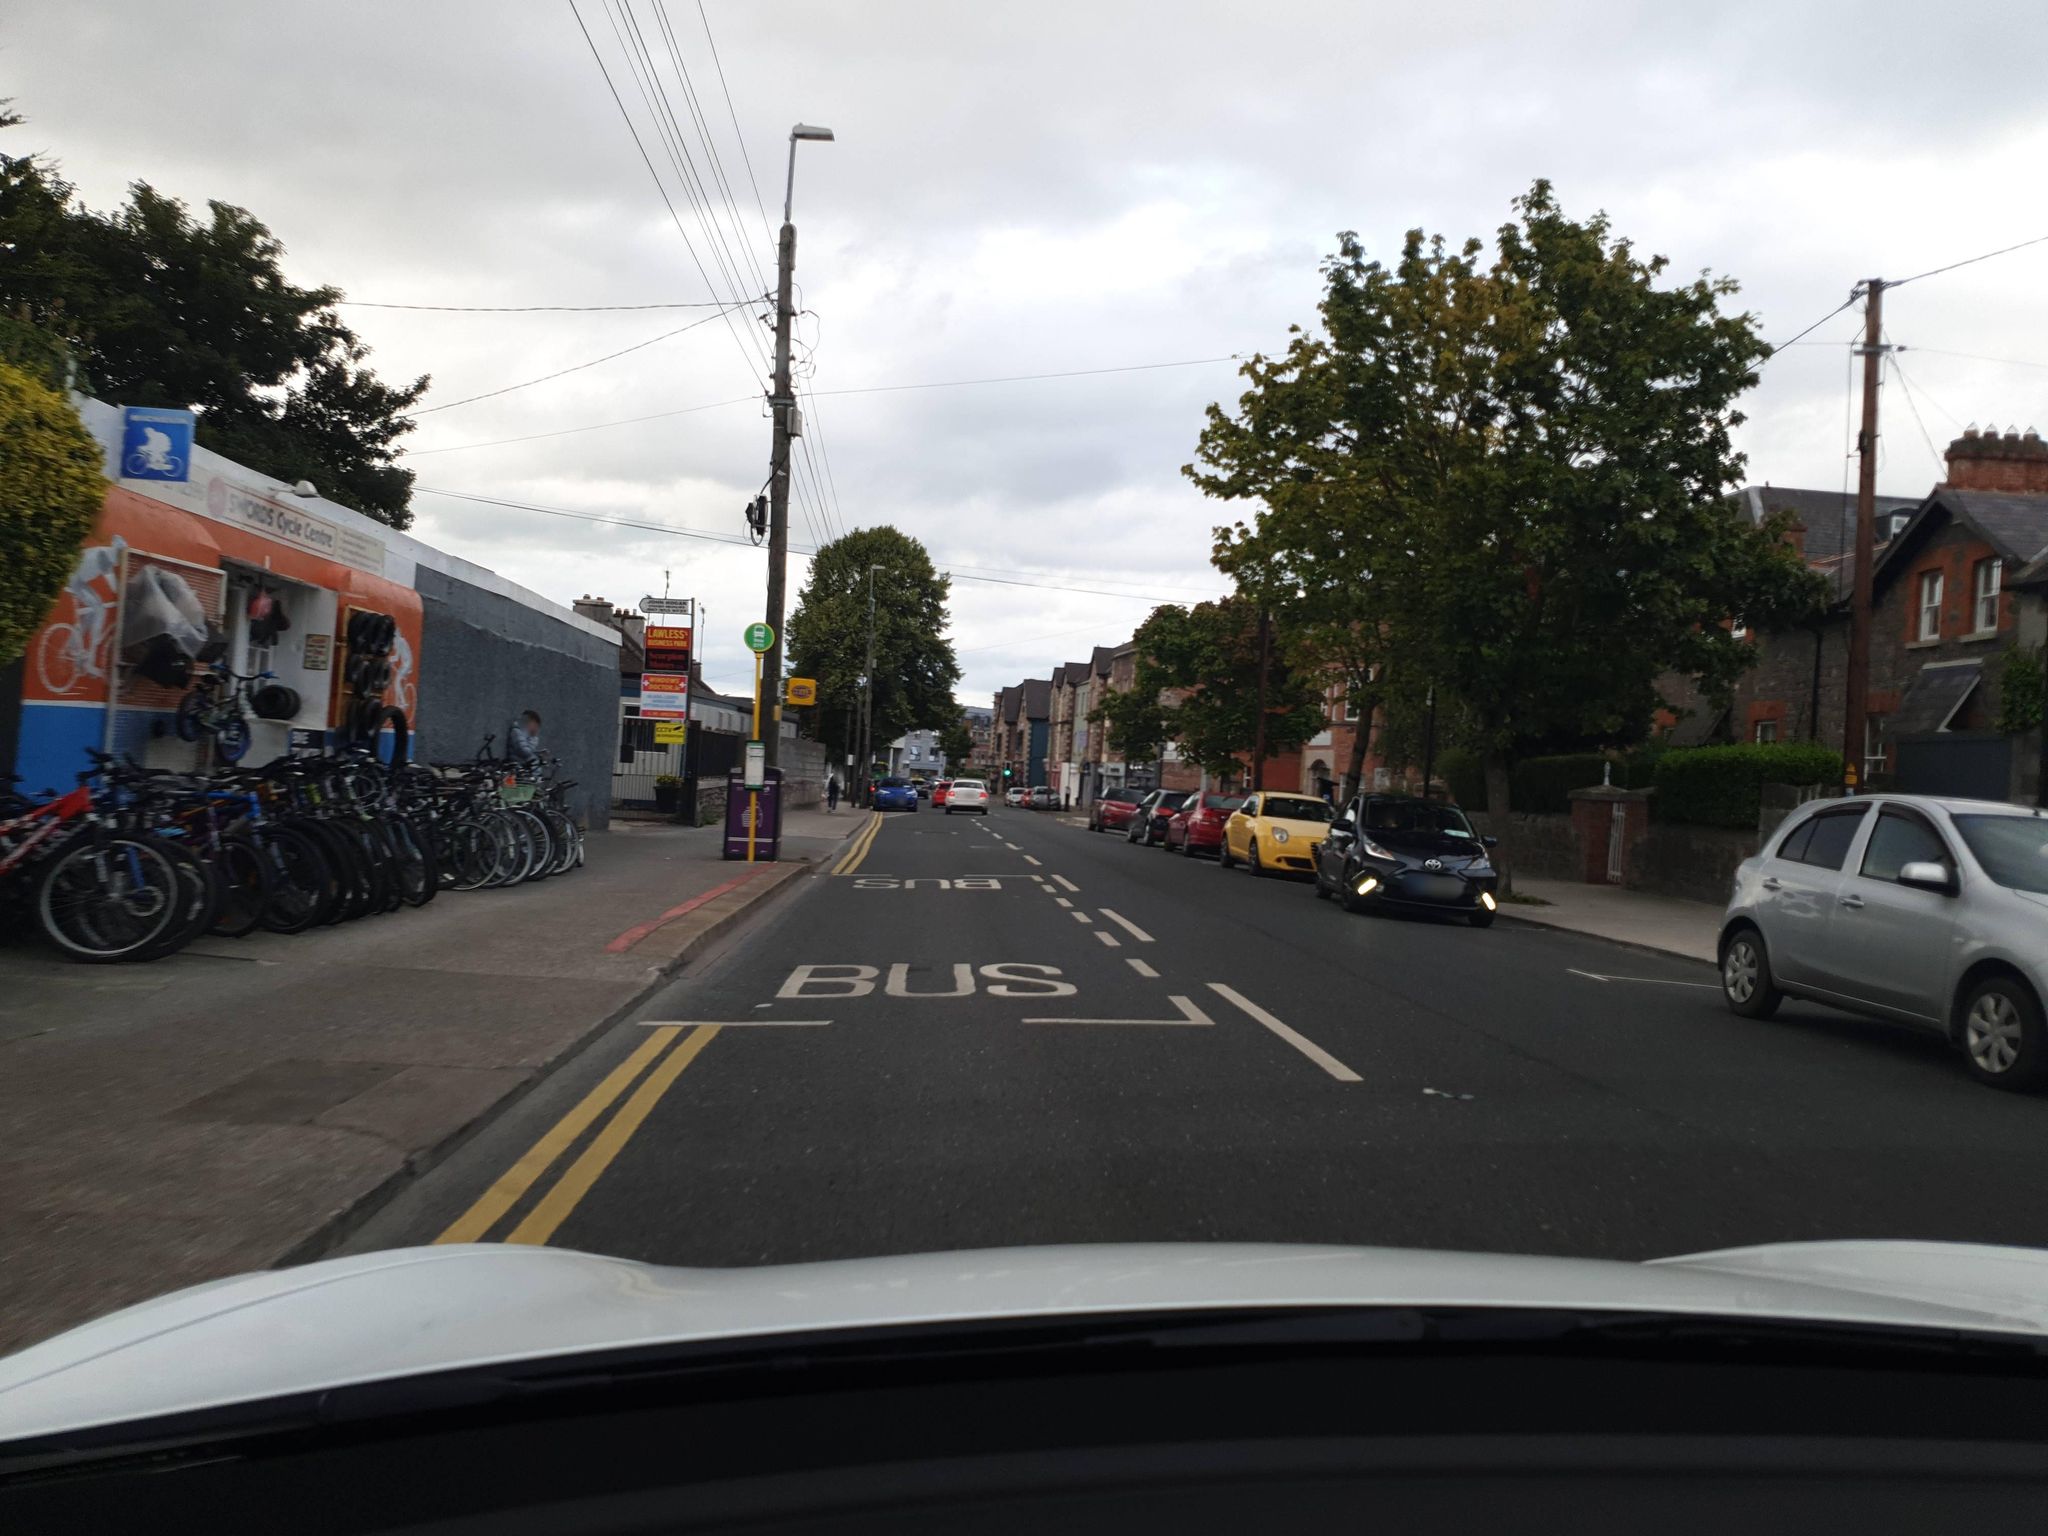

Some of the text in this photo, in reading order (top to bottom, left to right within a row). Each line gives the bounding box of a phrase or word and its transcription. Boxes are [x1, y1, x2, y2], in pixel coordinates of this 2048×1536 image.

[276, 511, 303, 537] Cycle
[303, 521, 333, 549] Centre
[852, 878, 1002, 889] BUS
[775, 963, 1078, 998] BUS
